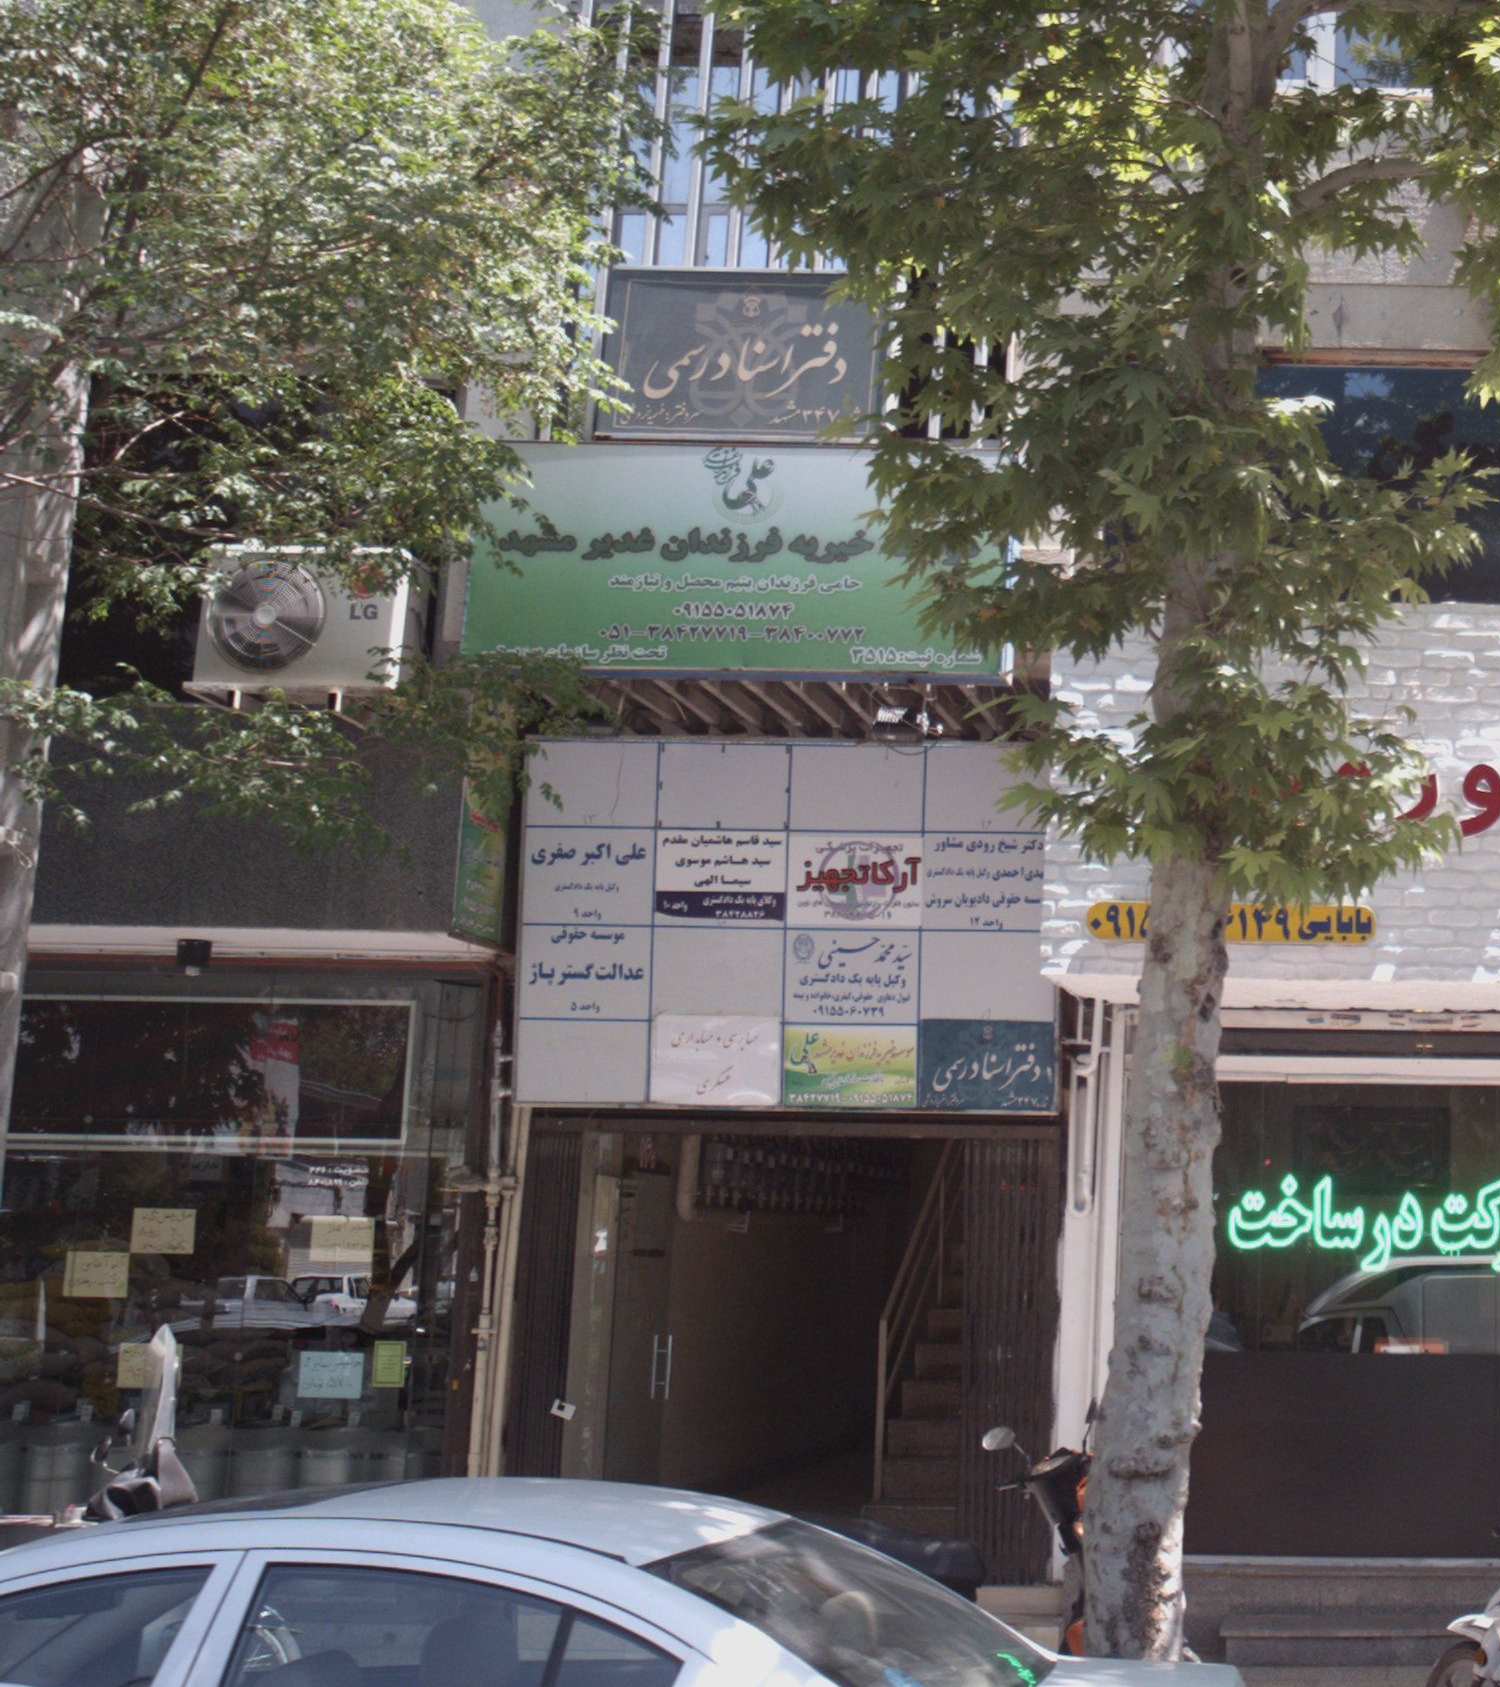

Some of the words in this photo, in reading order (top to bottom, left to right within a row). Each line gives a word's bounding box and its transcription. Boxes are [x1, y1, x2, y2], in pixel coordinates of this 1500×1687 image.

[710, 337, 794, 381] اسناد
[766, 322, 848, 398] دفتر
[643, 344, 710, 399] رسمی
[500, 530, 578, 558] مشهد
[581, 527, 655, 561] غدیر
[660, 525, 783, 562] فرزندان
[788, 529, 875, 564] خیریه
[609, 574, 660, 592] نیازمند
[663, 579, 672, 590] و
[675, 572, 722, 591] محصل
[724, 576, 752, 593] یتیم
[757, 574, 816, 593] فرزندان
[819, 576, 862, 594] حامی
[350, 603, 378, 620] LG
[599, 644, 631, 663] نظر
[632, 643, 668, 660] تحت
[662, 835, 688, 847] مقدم
[691, 834, 733, 848] هاشمیان
[735, 834, 760, 847] قاسم
[762, 835, 782, 847] سید
[1020, 838, 1044, 854] دکتر
[531, 843, 576, 866] صفری
[579, 843, 611, 867] اکبر
[616, 843, 647, 866] علی
[675, 857, 711, 868] موسوی
[714, 855, 748, 867] هاشم
[751, 856, 771, 867] سید
[693, 874, 717, 888] الهی
[720, 875, 752, 887] سیما
[580, 910, 602, 921] واحد
[1298, 908, 1373, 942] بابایی
[551, 927, 587, 945] حقوقی
[590, 929, 626, 945] موسسه
[817, 936, 881, 970] حسینی
[528, 961, 556, 986] پاژ
[557, 962, 595, 986] گستر
[598, 962, 645, 982] عدالت
[800, 973, 846, 987] دادگستری
[848, 973, 863, 986] یک
[865, 973, 882, 988] پایه
[884, 973, 907, 989] وکیل
[578, 1001, 601, 1013] واحد
[932, 1055, 966, 1092] رسمی
[970, 1050, 1011, 1083] اسناد
[999, 1043, 1042, 1091] دفتر
[1228, 1172, 1365, 1250] ساخت
[1360, 1190, 1424, 1272] در
